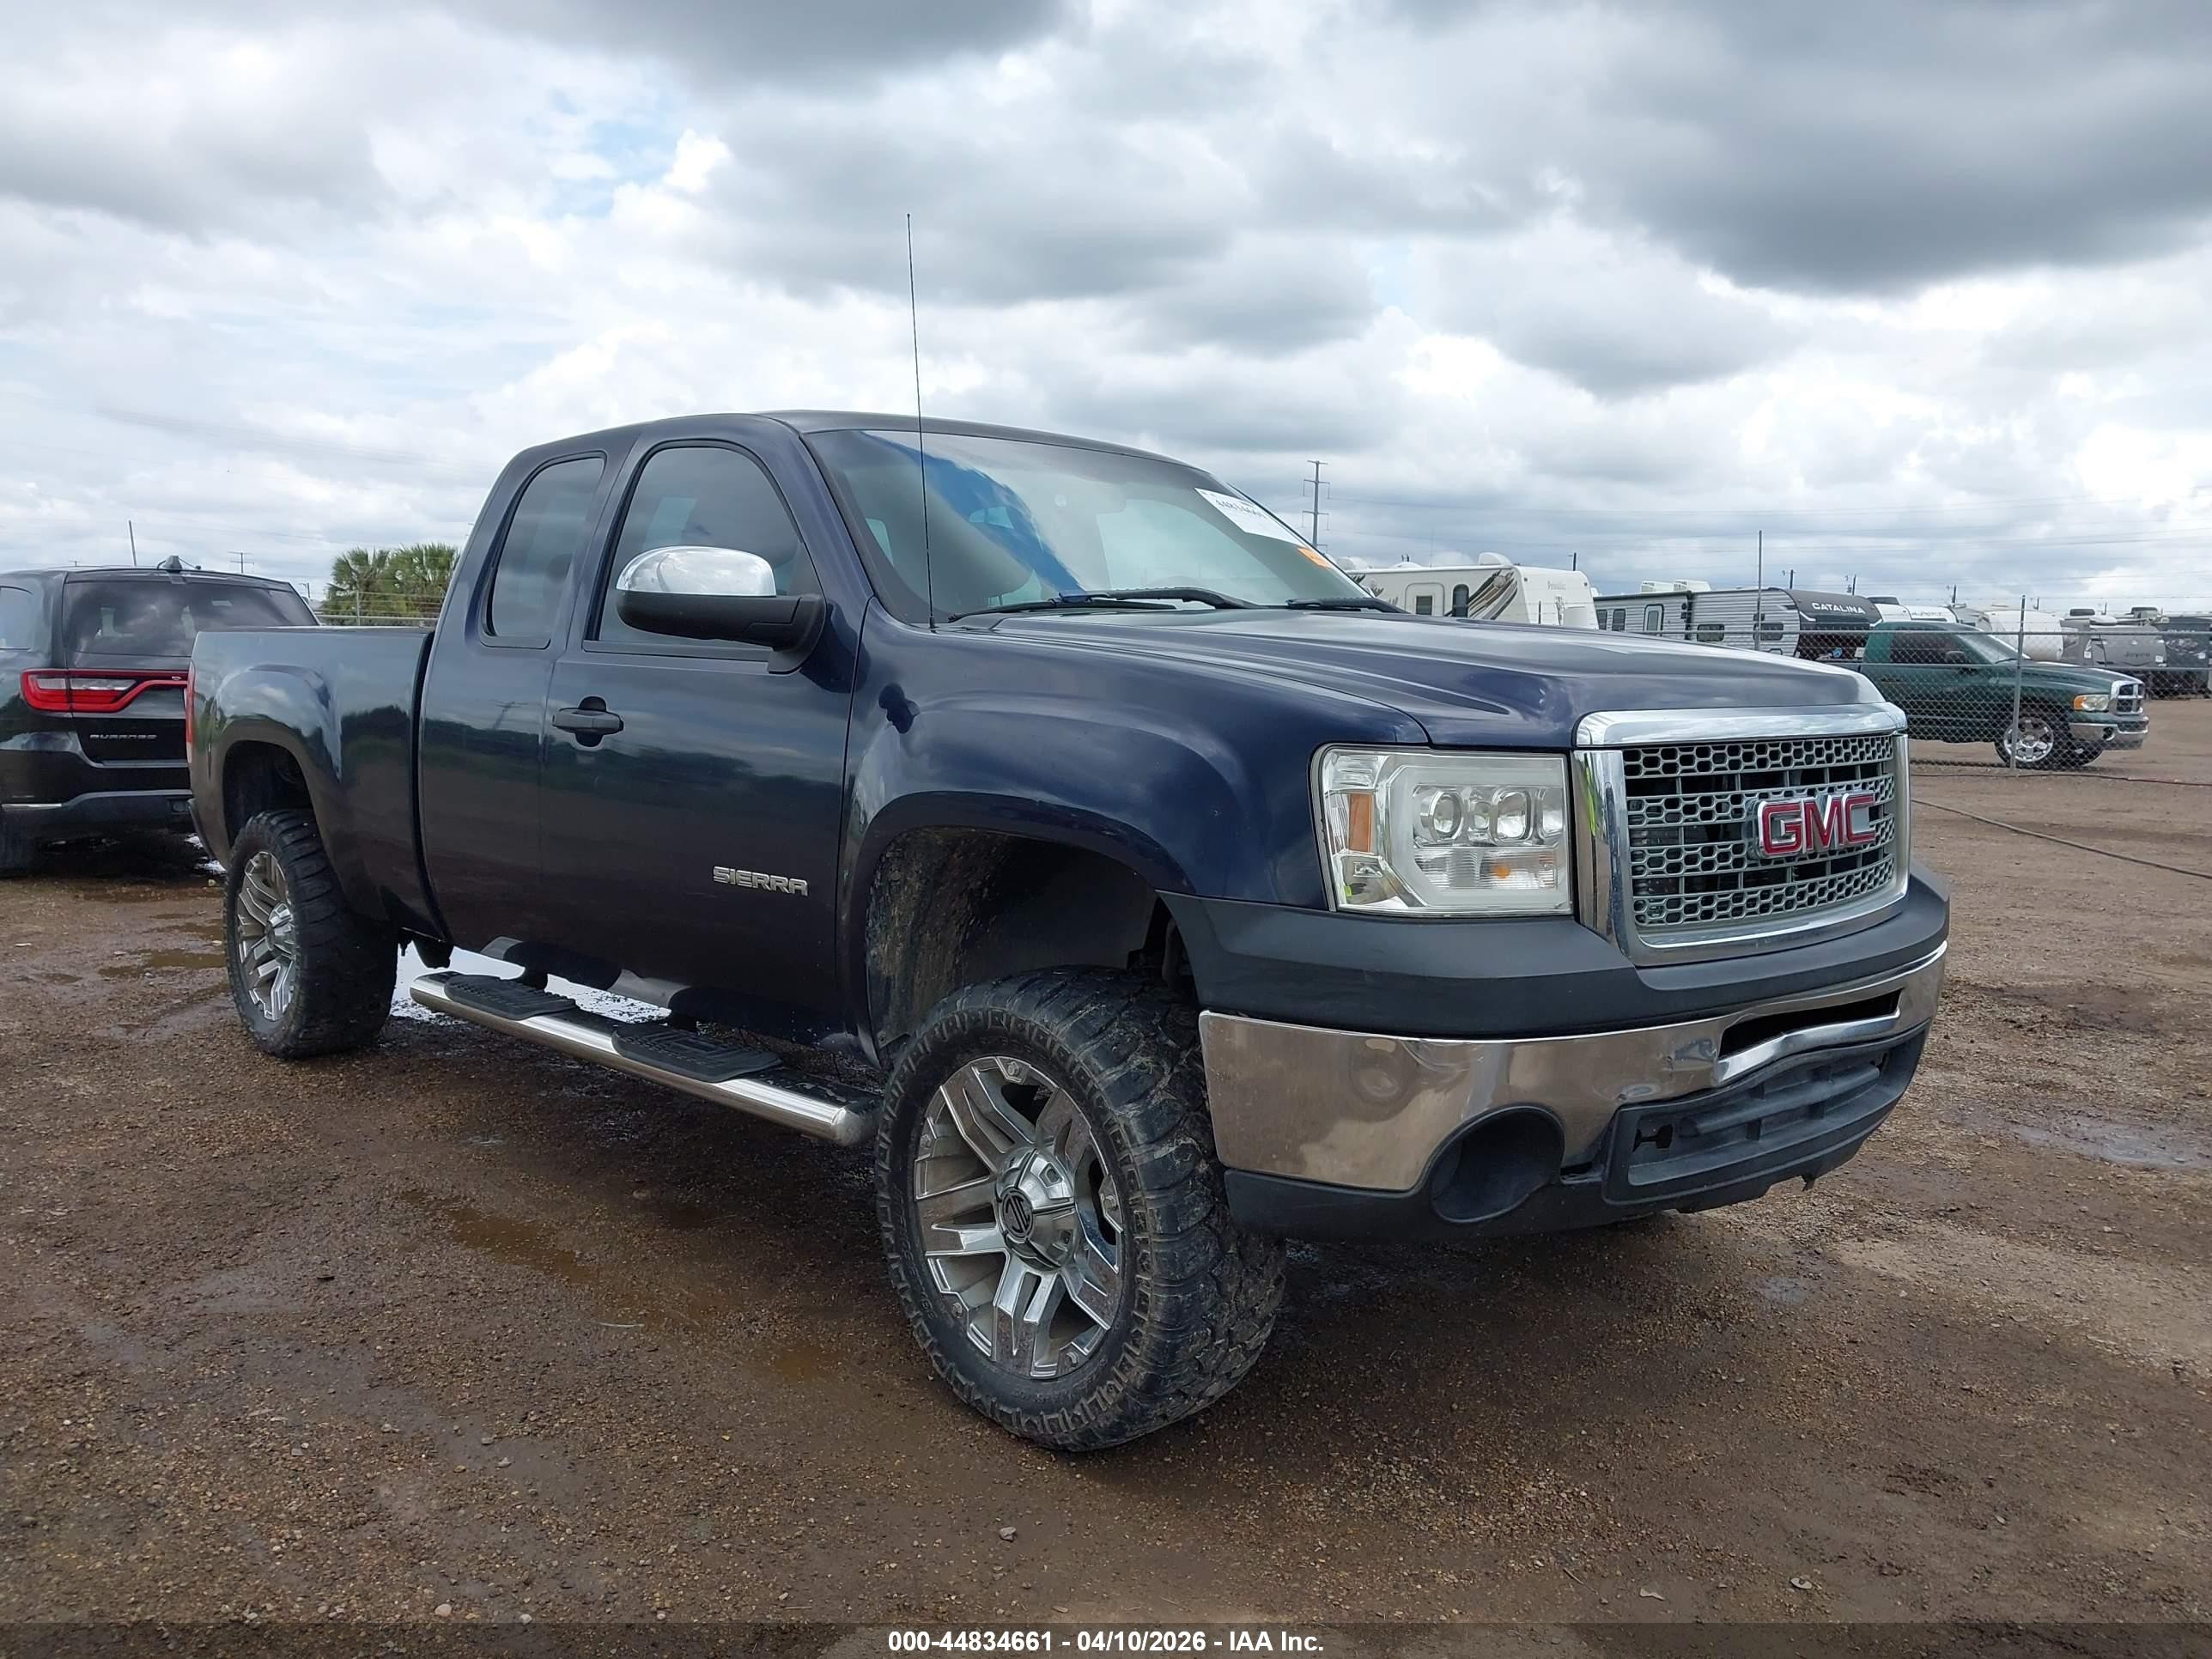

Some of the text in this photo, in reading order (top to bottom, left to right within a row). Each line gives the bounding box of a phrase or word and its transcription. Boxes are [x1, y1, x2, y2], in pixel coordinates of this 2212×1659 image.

[1812, 602, 1866, 615] CATALINA
[1758, 790, 1876, 858] GMC
[713, 866, 808, 896] SIERRA
